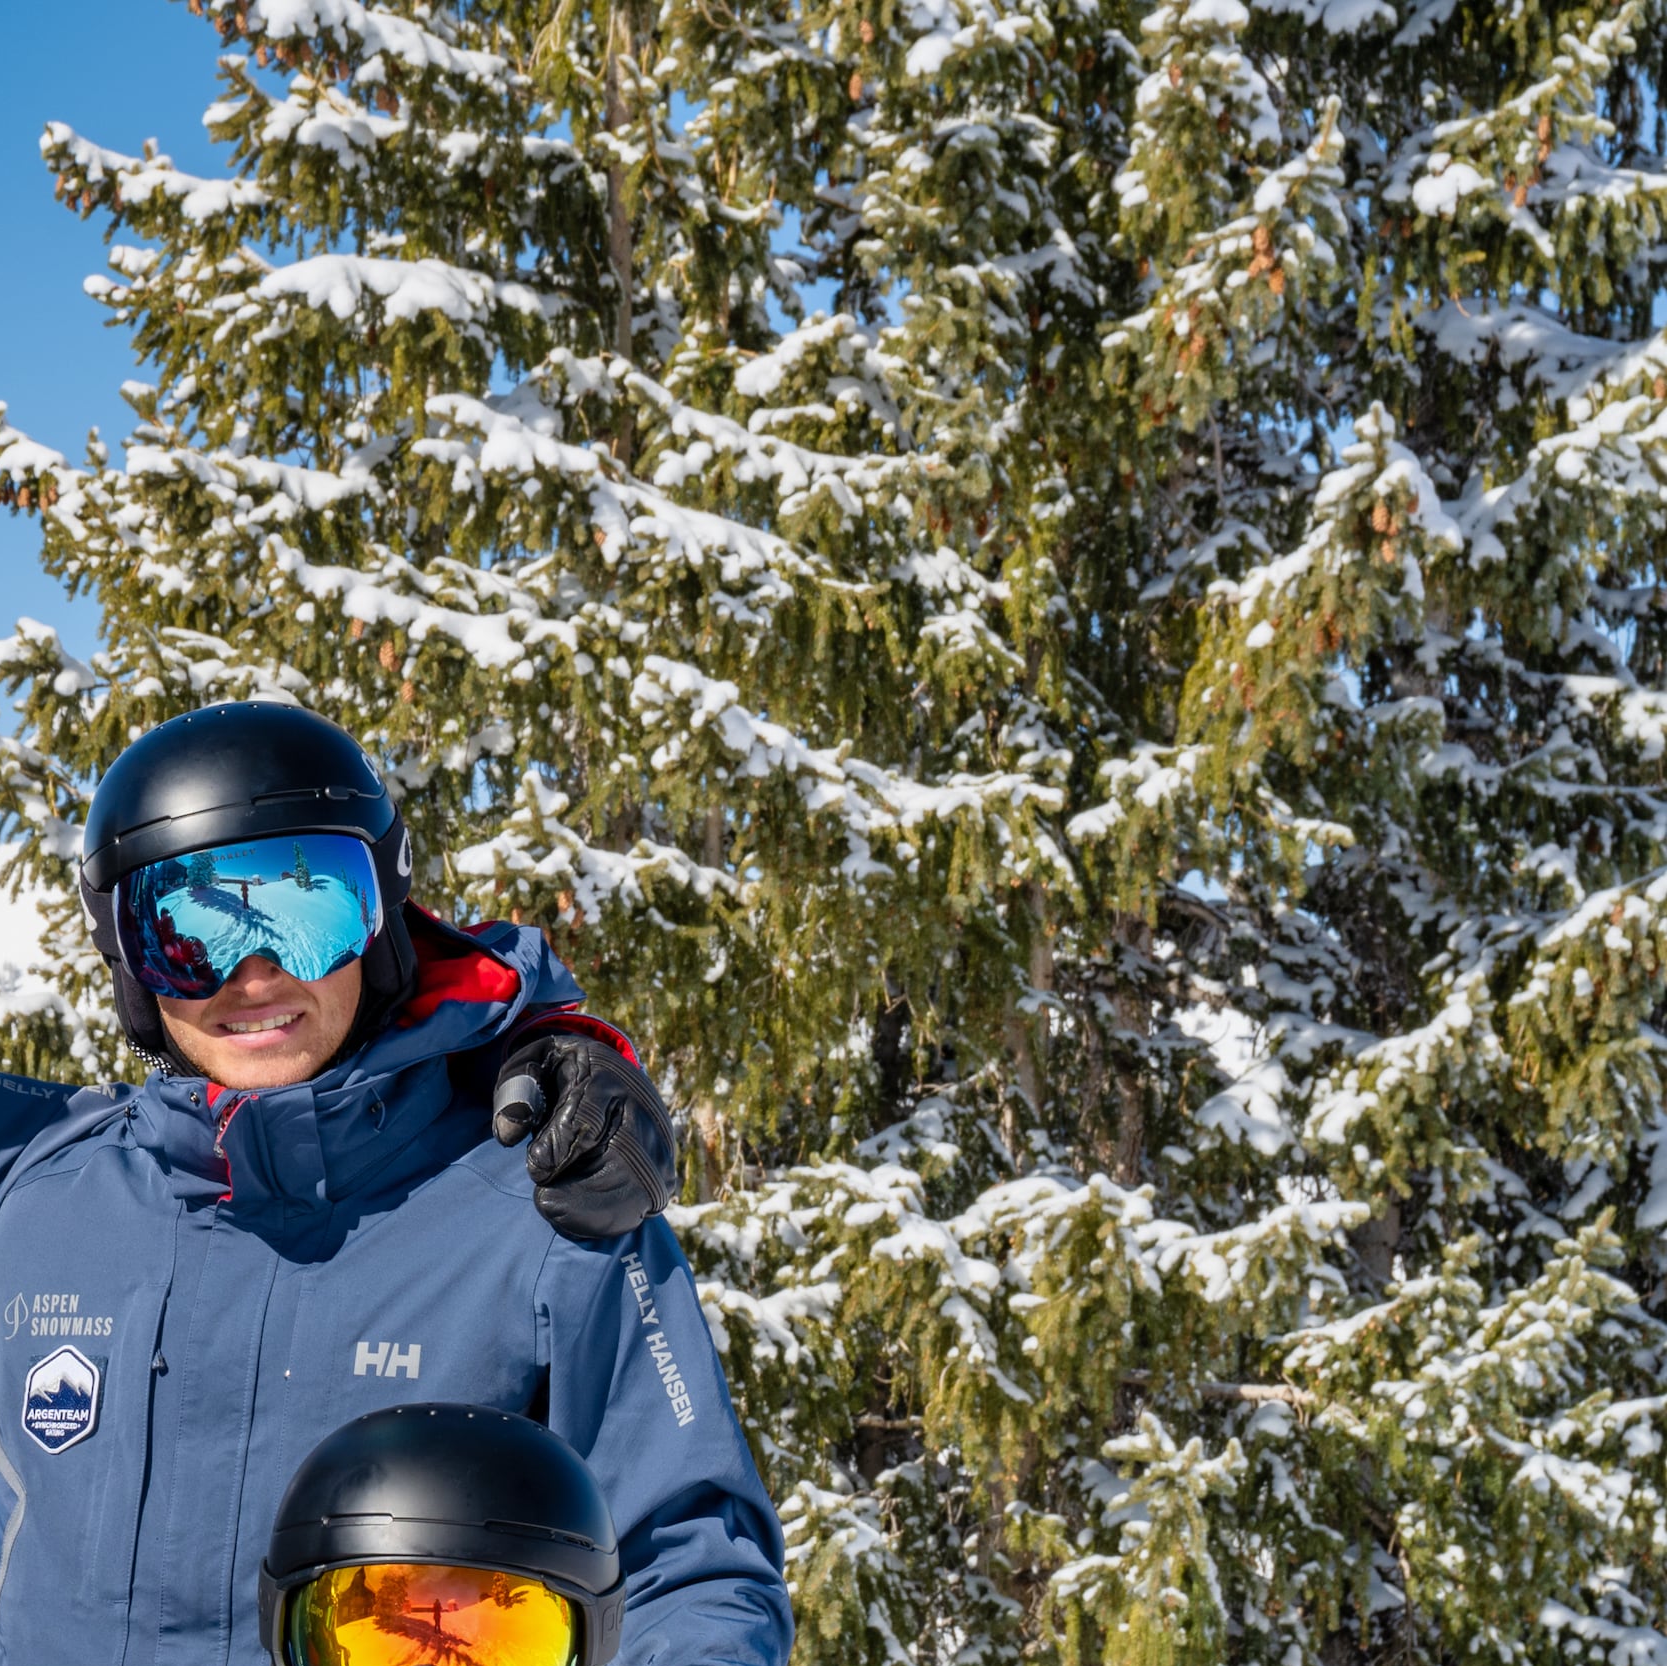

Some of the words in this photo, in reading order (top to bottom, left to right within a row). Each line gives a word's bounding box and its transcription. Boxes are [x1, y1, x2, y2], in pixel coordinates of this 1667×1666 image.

[620, 1252, 660, 1325] HELLY
[32, 1294, 80, 1313] ASPEN
[30, 1317, 114, 1336] SNOWMASS
[353, 1341, 422, 1379] HH
[646, 1331, 696, 1428] HANSEN
[27, 1409, 89, 1421] ARGENTEAM
